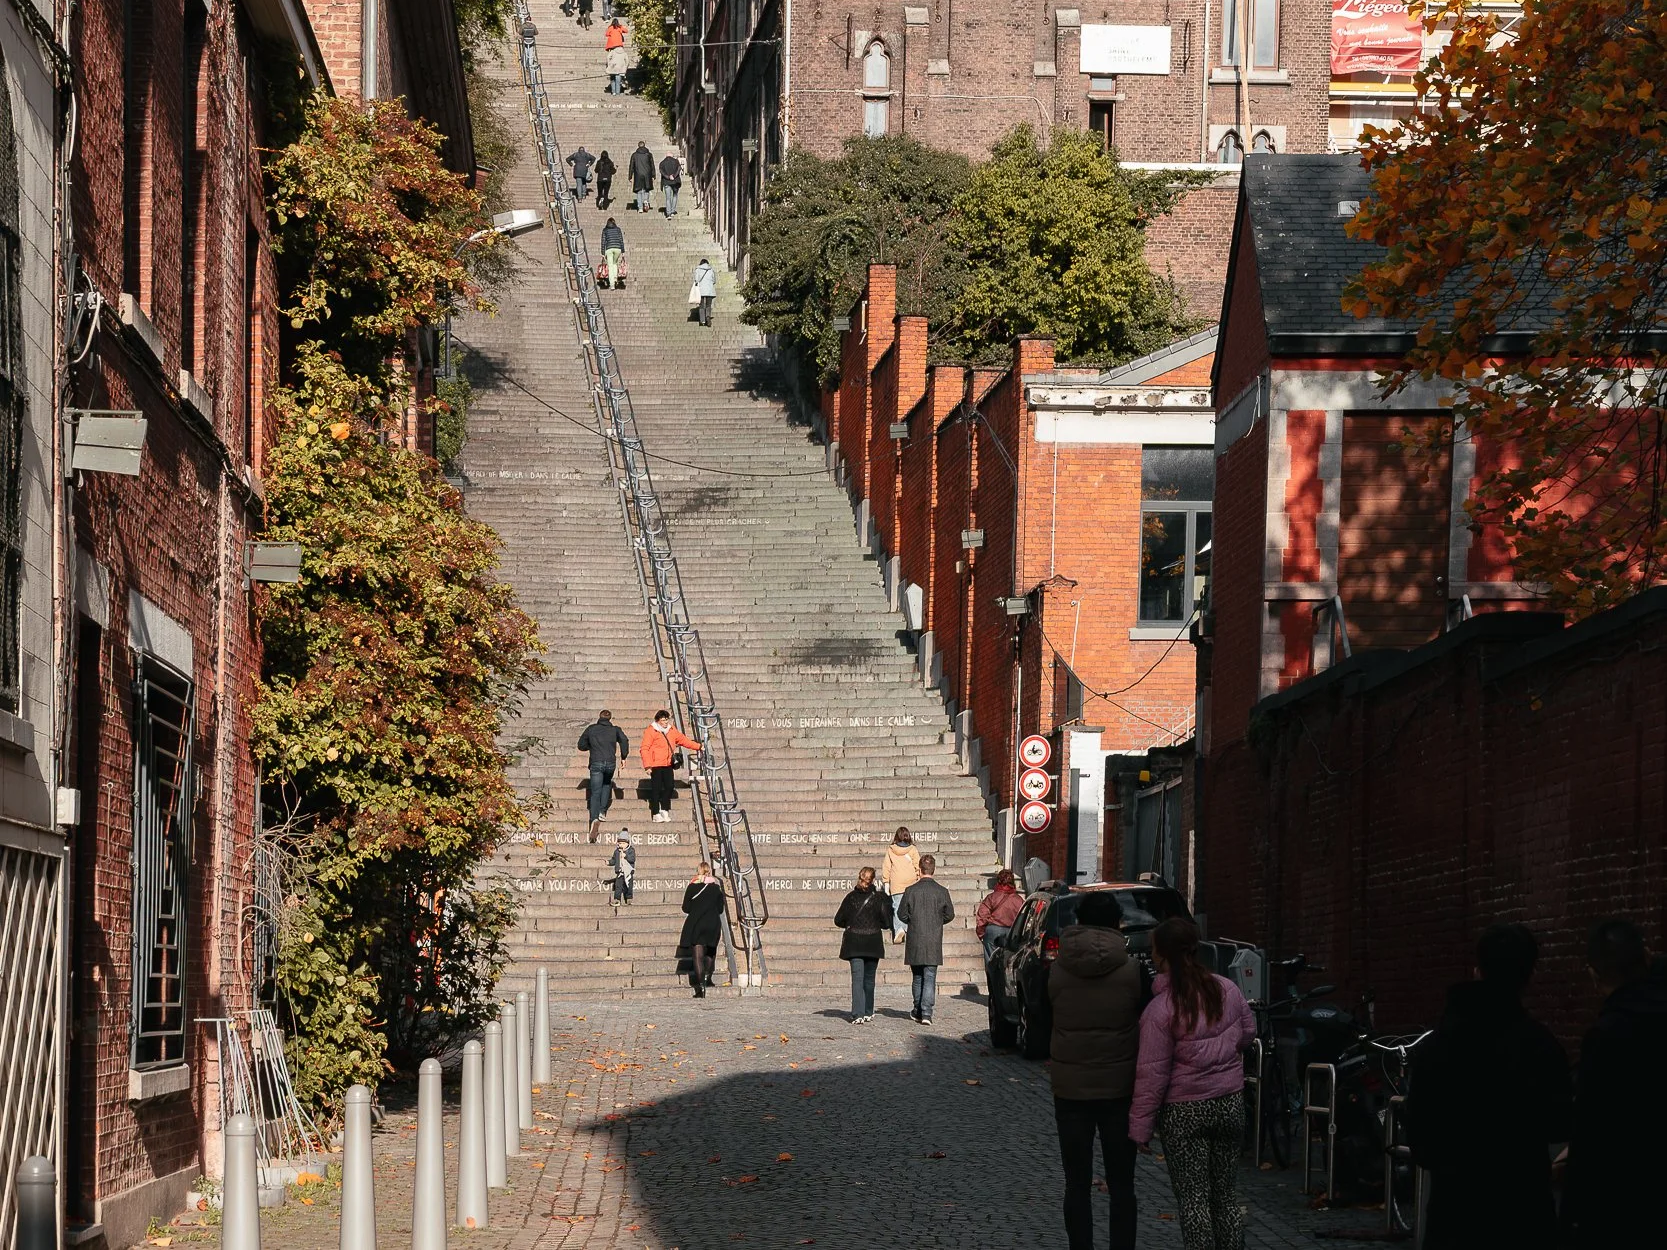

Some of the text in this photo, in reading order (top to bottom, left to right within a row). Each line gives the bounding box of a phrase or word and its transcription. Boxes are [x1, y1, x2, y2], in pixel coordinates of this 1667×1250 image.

[727, 718, 753, 728] MERCI
[756, 718, 766, 728] DE
[771, 717, 792, 728] VOUS
[849, 717, 870, 727] DANS
[874, 716, 883, 727] LE
[887, 715, 915, 726] CALME
[604, 832, 643, 844] RUIGE
[647, 833, 679, 844] BEZOEK
[780, 833, 823, 843] BESUCHEN
[827, 834, 838, 843] SIE
[849, 832, 871, 842] OHNE
[880, 833, 891, 841] ZU
[548, 879, 567, 891] YOU
[569, 879, 591, 892] FOR
[765, 880, 793, 890] MERCI
[802, 880, 812, 890] DE
[816, 879, 853, 889] VISITER
